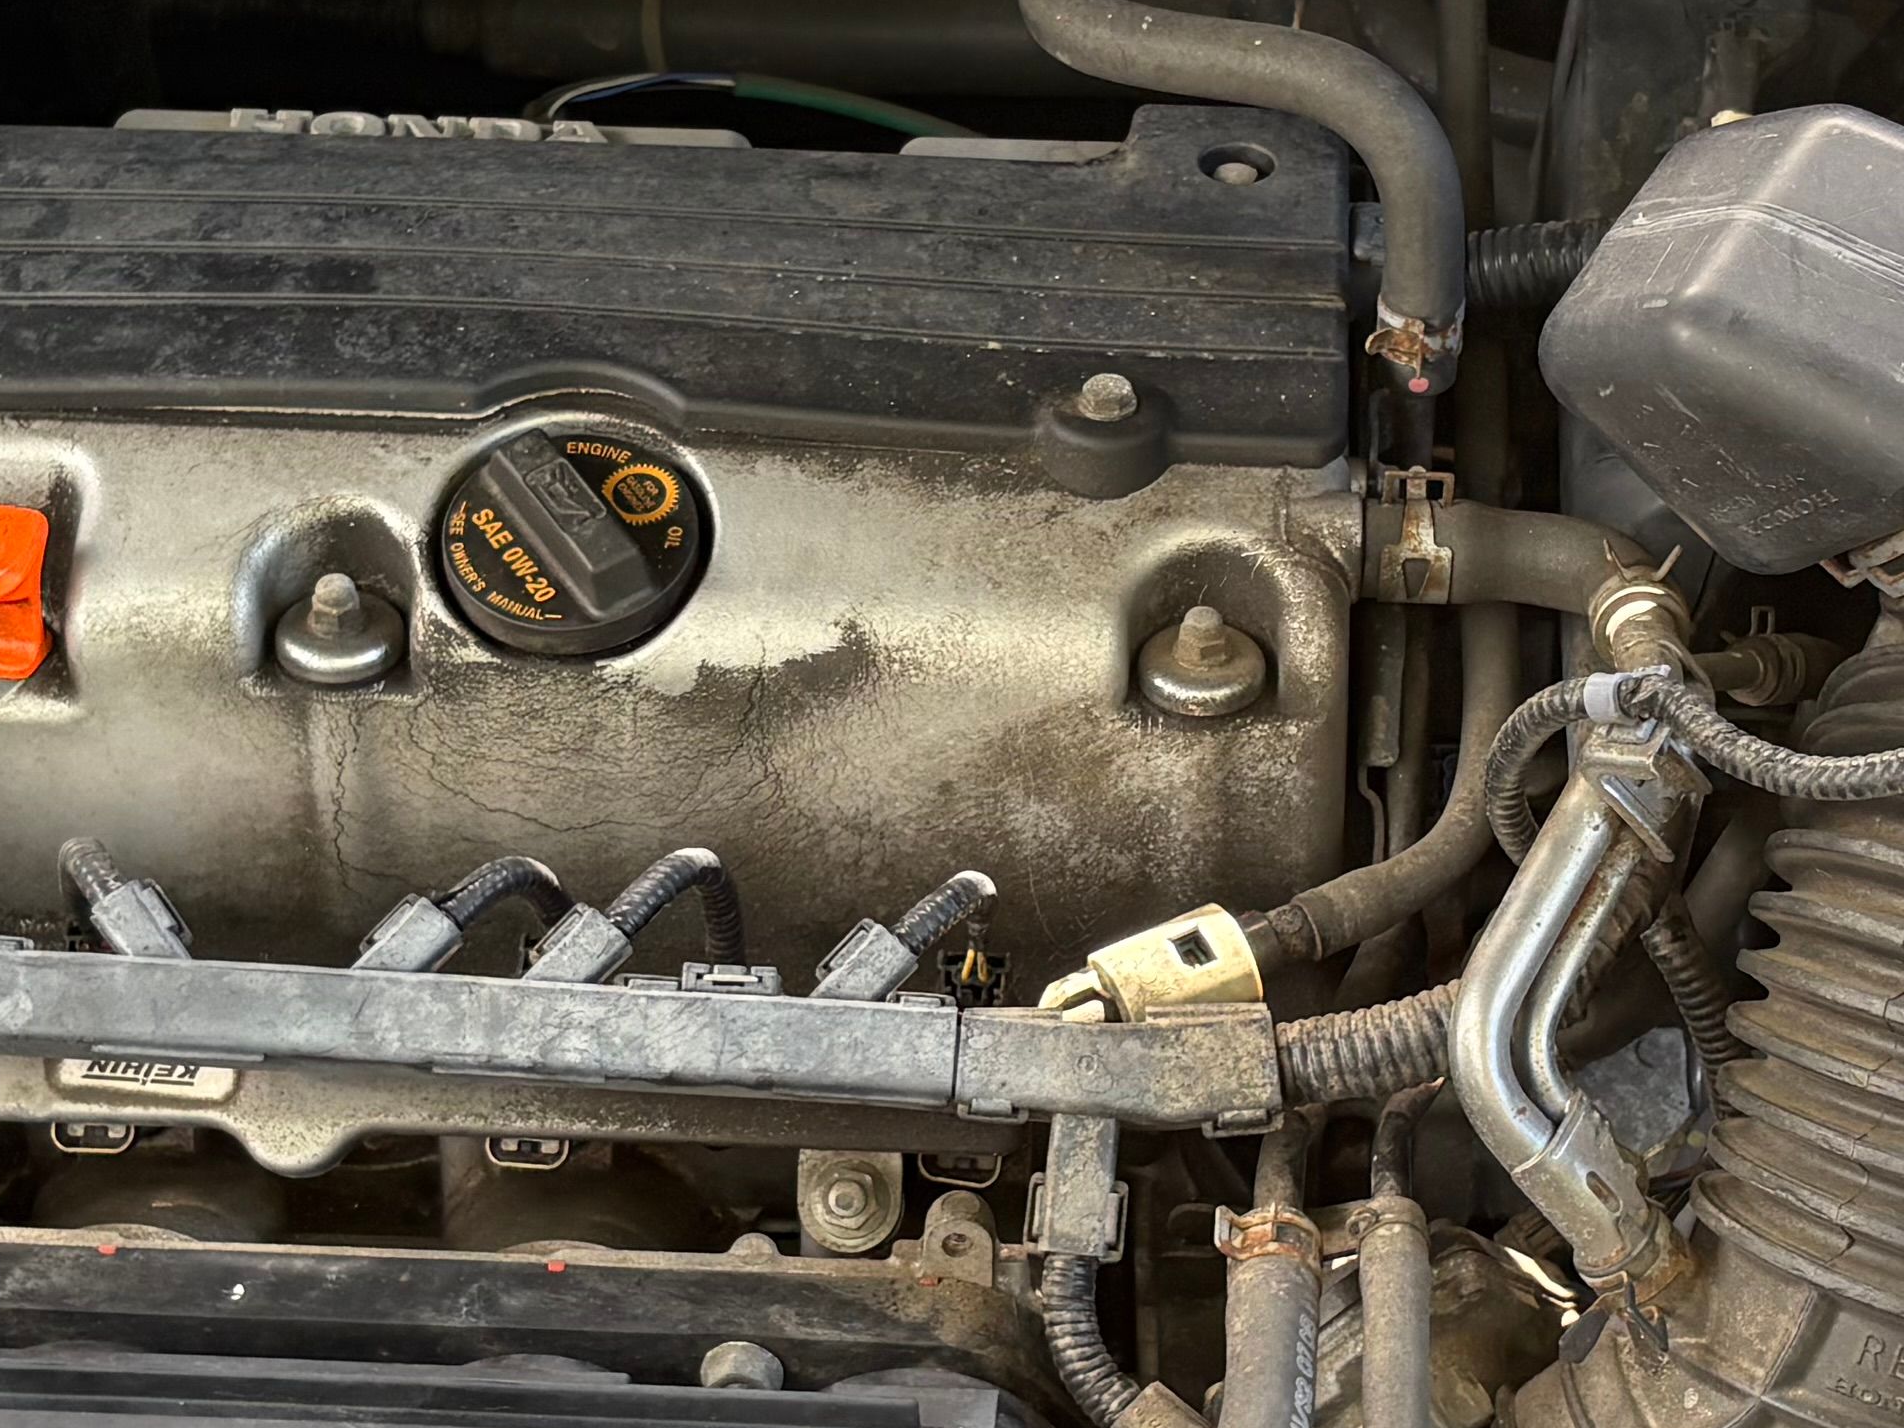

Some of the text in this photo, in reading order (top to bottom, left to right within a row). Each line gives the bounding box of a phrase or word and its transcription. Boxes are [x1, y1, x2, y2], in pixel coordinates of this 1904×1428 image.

[566, 441, 684, 549] ENGINE OIL
[472, 508, 513, 549] SAE
[450, 542, 486, 593] OWNER'S
[84, 1058, 201, 1086] KEIHIN
